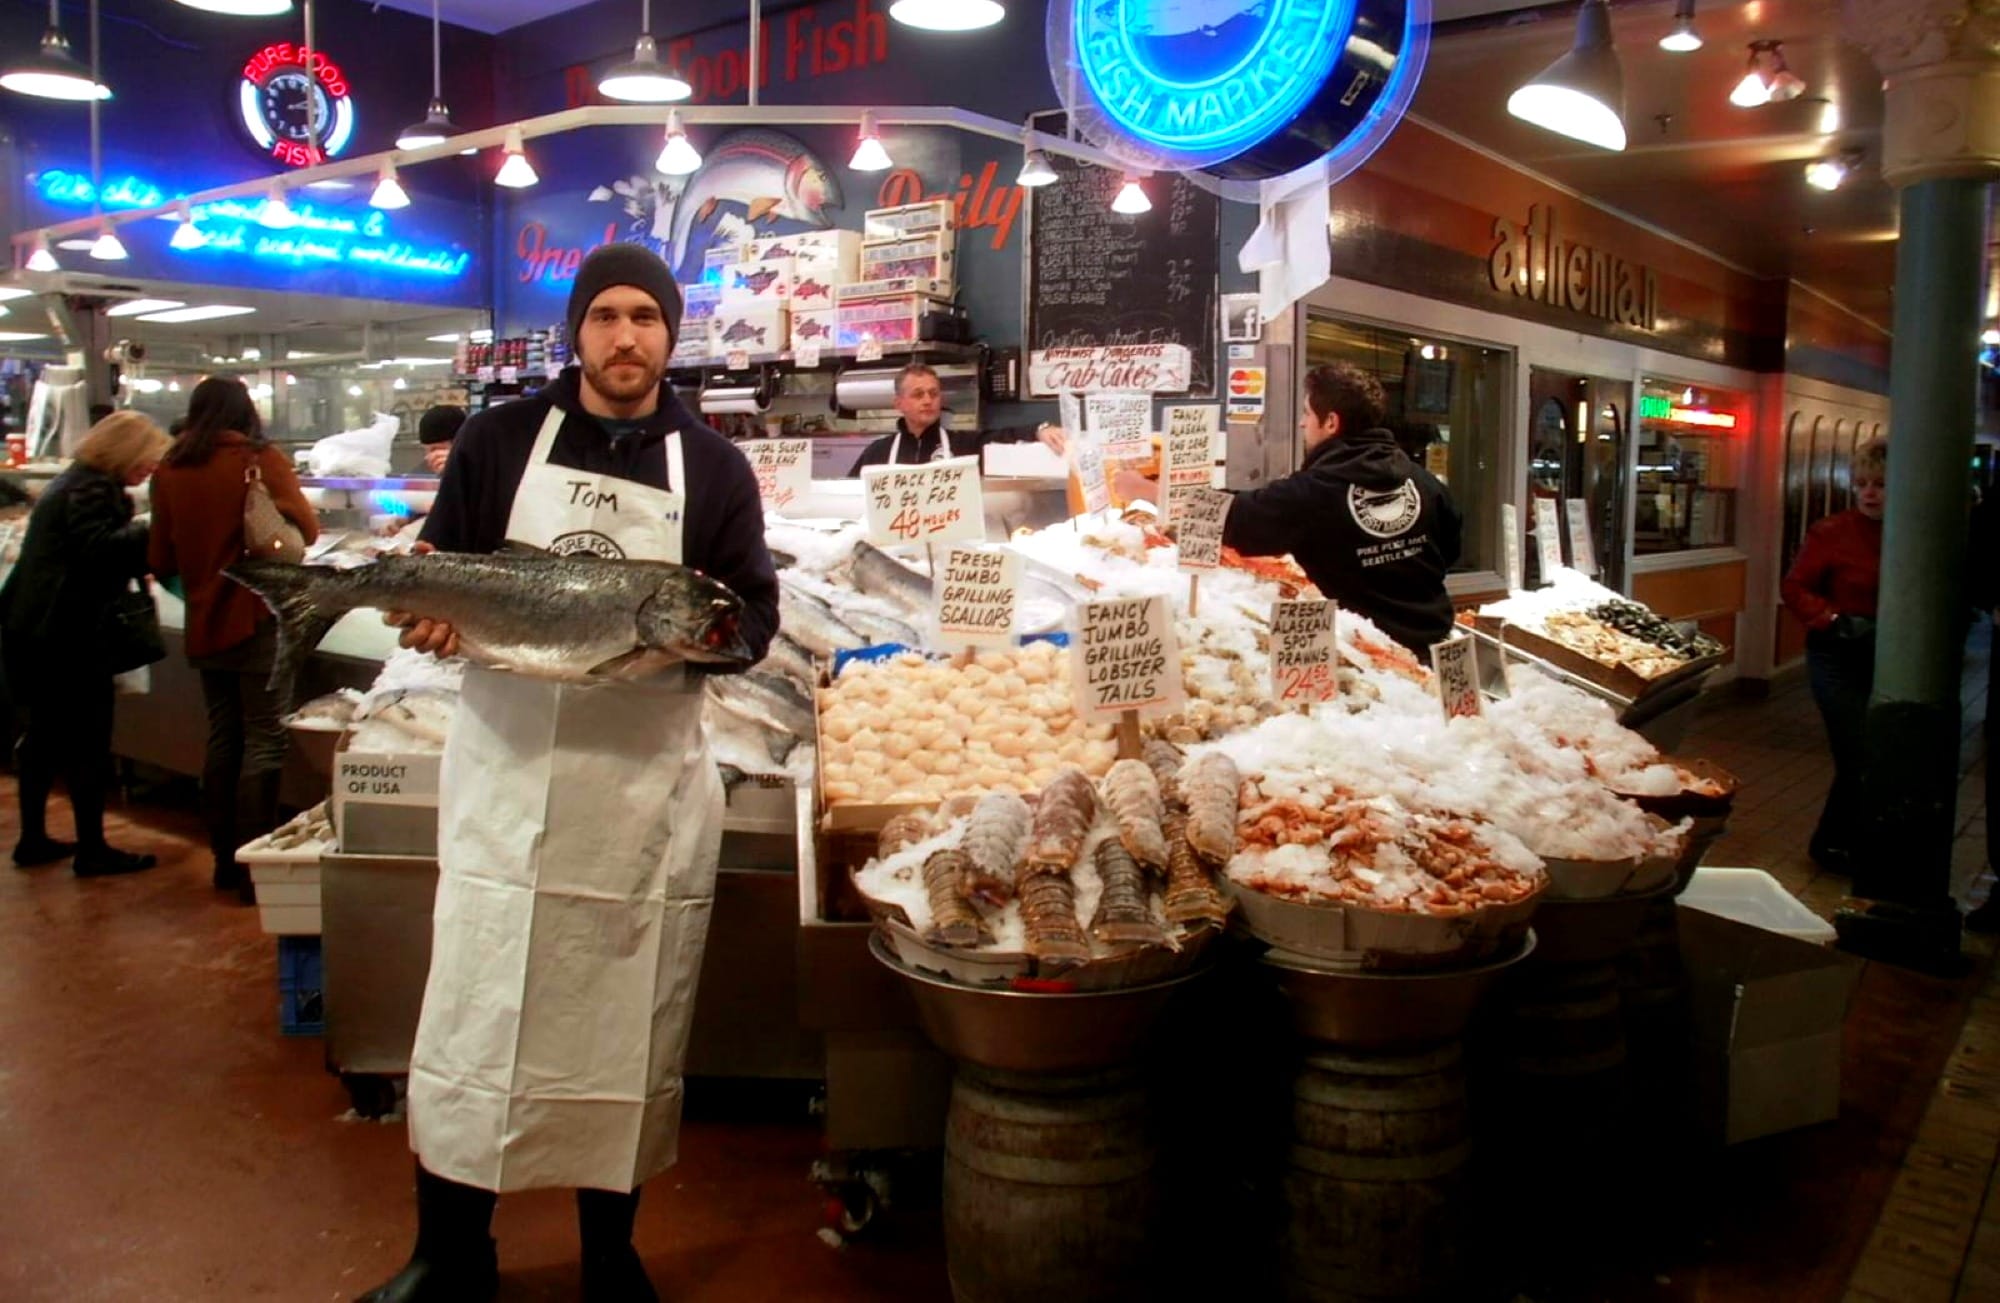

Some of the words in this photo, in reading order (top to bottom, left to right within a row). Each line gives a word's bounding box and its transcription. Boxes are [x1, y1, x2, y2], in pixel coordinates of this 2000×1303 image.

[785, 0, 888, 82] Fish
[243, 42, 293, 83] PURE
[298, 46, 347, 97] FOOD
[1088, 34, 1151, 123] FISH
[1168, 3, 1322, 128] MARKET
[879, 161, 1024, 250] Dily
[1489, 203, 1657, 321] athenian
[1172, 408, 1205, 422] FANCY
[871, 475, 889, 493] WE
[894, 473, 926, 489] PACK
[932, 468, 963, 483] FISH
[567, 480, 618, 513] TOM
[875, 494, 891, 509] TO
[901, 490, 918, 507] GO
[927, 485, 957, 504] FOR
[889, 508, 920, 539] 48
[923, 508, 960, 525] HOURS
[950, 550, 1004, 569] FRESH
[944, 568, 1000, 585] JUMBO
[942, 586, 1014, 605] GRILLING
[939, 604, 1014, 629] SCALLOPS
[1088, 598, 1152, 622] FANCY
[1279, 602, 1328, 618] FRESH
[1083, 620, 1149, 645] JUMBO
[1271, 615, 1331, 635] ALASKAN
[1085, 638, 1162, 665] GRILLING
[1283, 633, 1317, 650] SPOT
[1277, 646, 1329, 666] PRAWNS
[1088, 656, 1166, 684] LOBSTER
[1096, 679, 1156, 704] TAILS
[342, 764, 407, 778] PRODUCT
[348, 781, 367, 793] OF
[372, 781, 400, 794] USA
